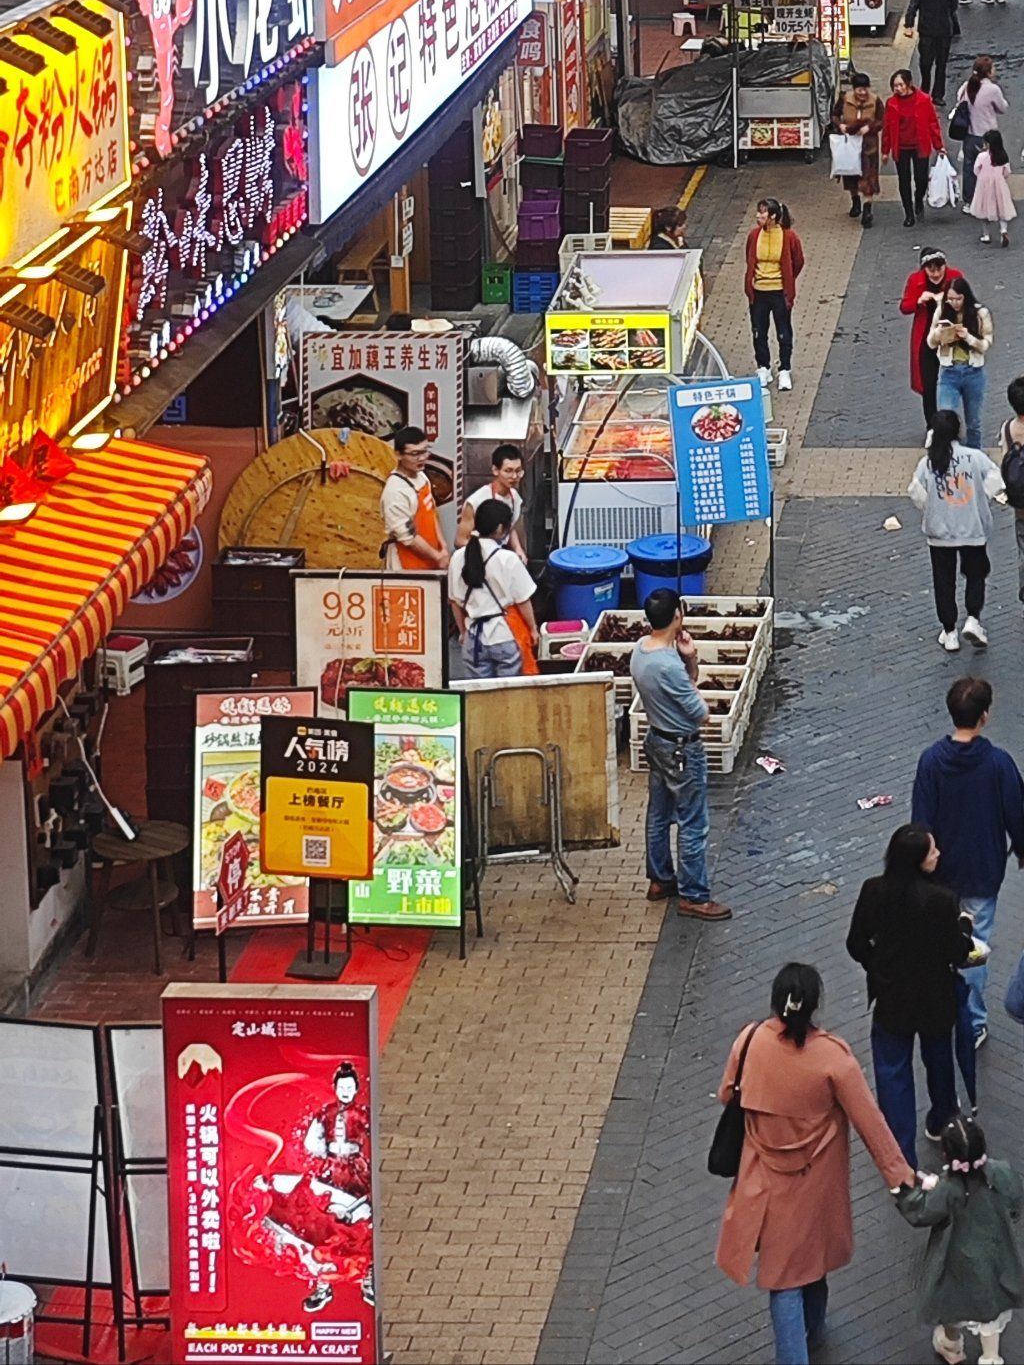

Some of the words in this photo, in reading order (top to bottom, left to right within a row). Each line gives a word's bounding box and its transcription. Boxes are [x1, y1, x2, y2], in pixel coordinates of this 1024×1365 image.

[521, 18, 541, 40] 食
[776, 20, 814, 34] 10元5个
[55, 139, 118, 213] 巴南万达店
[331, 343, 449, 371] 宜加藕王养生汤
[692, 388, 736, 402] 特色干锅
[323, 591, 366, 621] 98
[397, 591, 417, 647] 小龙虾
[284, 736, 349, 762] 人气榜
[296, 760, 339, 774] 2024
[288, 794, 345, 810] 上榜餐厅
[187, 1343, 218, 1353] EACH
[221, 1343, 245, 1353] POT
[255, 1343, 278, 1354] IT'S
[282, 1343, 305, 1354] ALL
[308, 1344, 318, 1354] A
[321, 1344, 358, 1355] CRAFT
